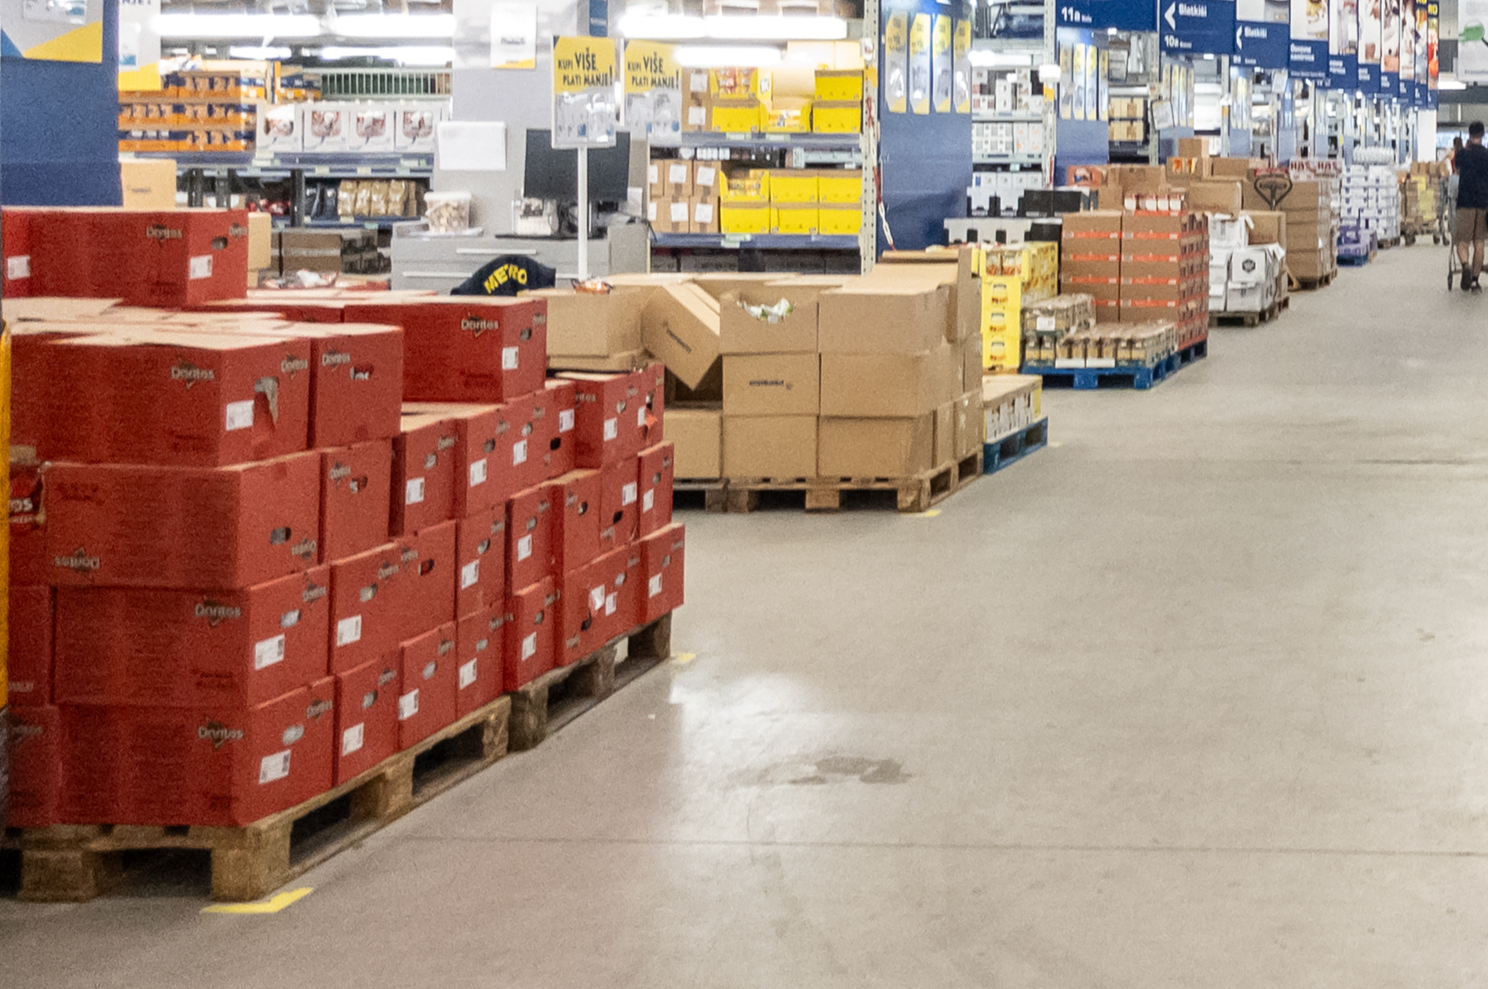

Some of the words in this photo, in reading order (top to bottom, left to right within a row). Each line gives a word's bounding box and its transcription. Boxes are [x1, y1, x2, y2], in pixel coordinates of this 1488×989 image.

[1061, 7, 1080, 22] 11a
[558, 60, 573, 71] KUPI
[563, 74, 582, 86] PLATI
[461, 318, 499, 330] Doritos
[171, 366, 215, 380] Doritos
[194, 603, 241, 618] Doritos
[198, 726, 244, 740] Doritos
